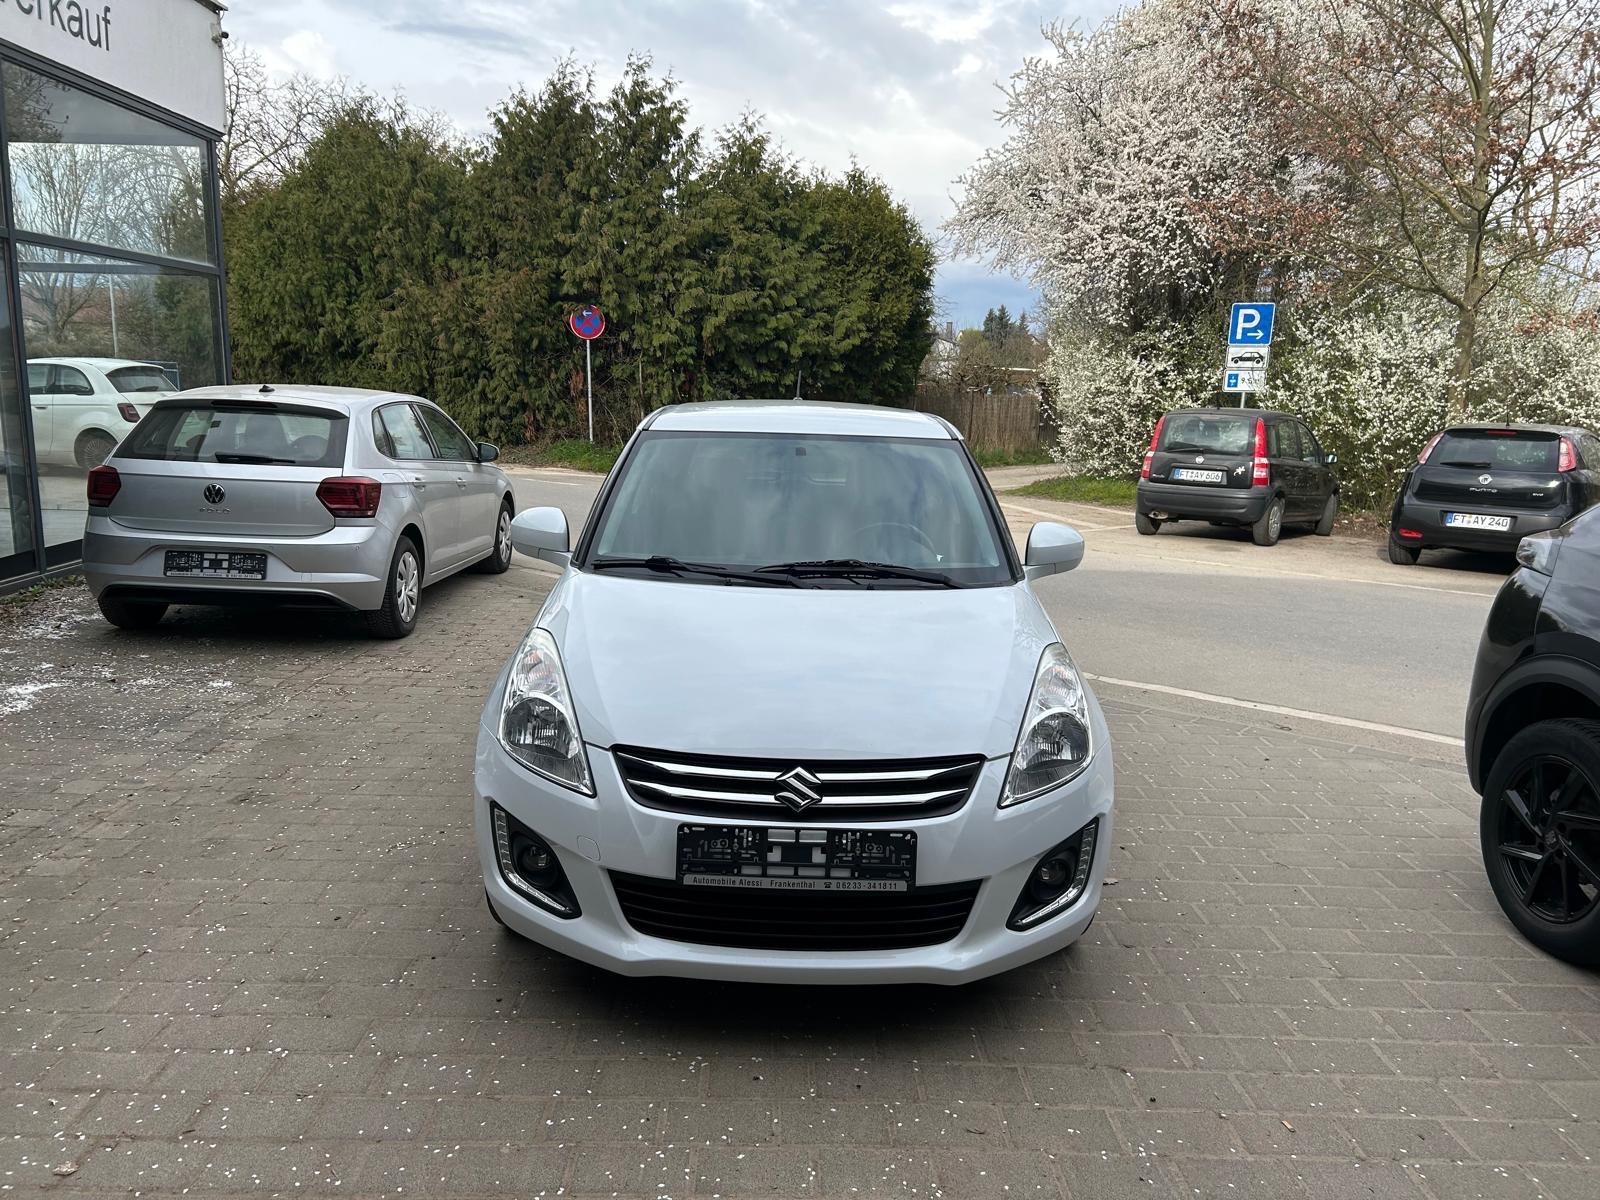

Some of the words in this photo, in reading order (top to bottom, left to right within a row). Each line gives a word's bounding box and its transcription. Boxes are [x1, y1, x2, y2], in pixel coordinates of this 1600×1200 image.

[1236, 309, 1260, 339] P
[1453, 514, 1465, 523] FT
[1472, 516, 1487, 525] AY
[1488, 517, 1509, 528] 240
[693, 877, 736, 886] Automobile
[740, 878, 762, 887] Alessi
[770, 880, 816, 888] Frankenthal
